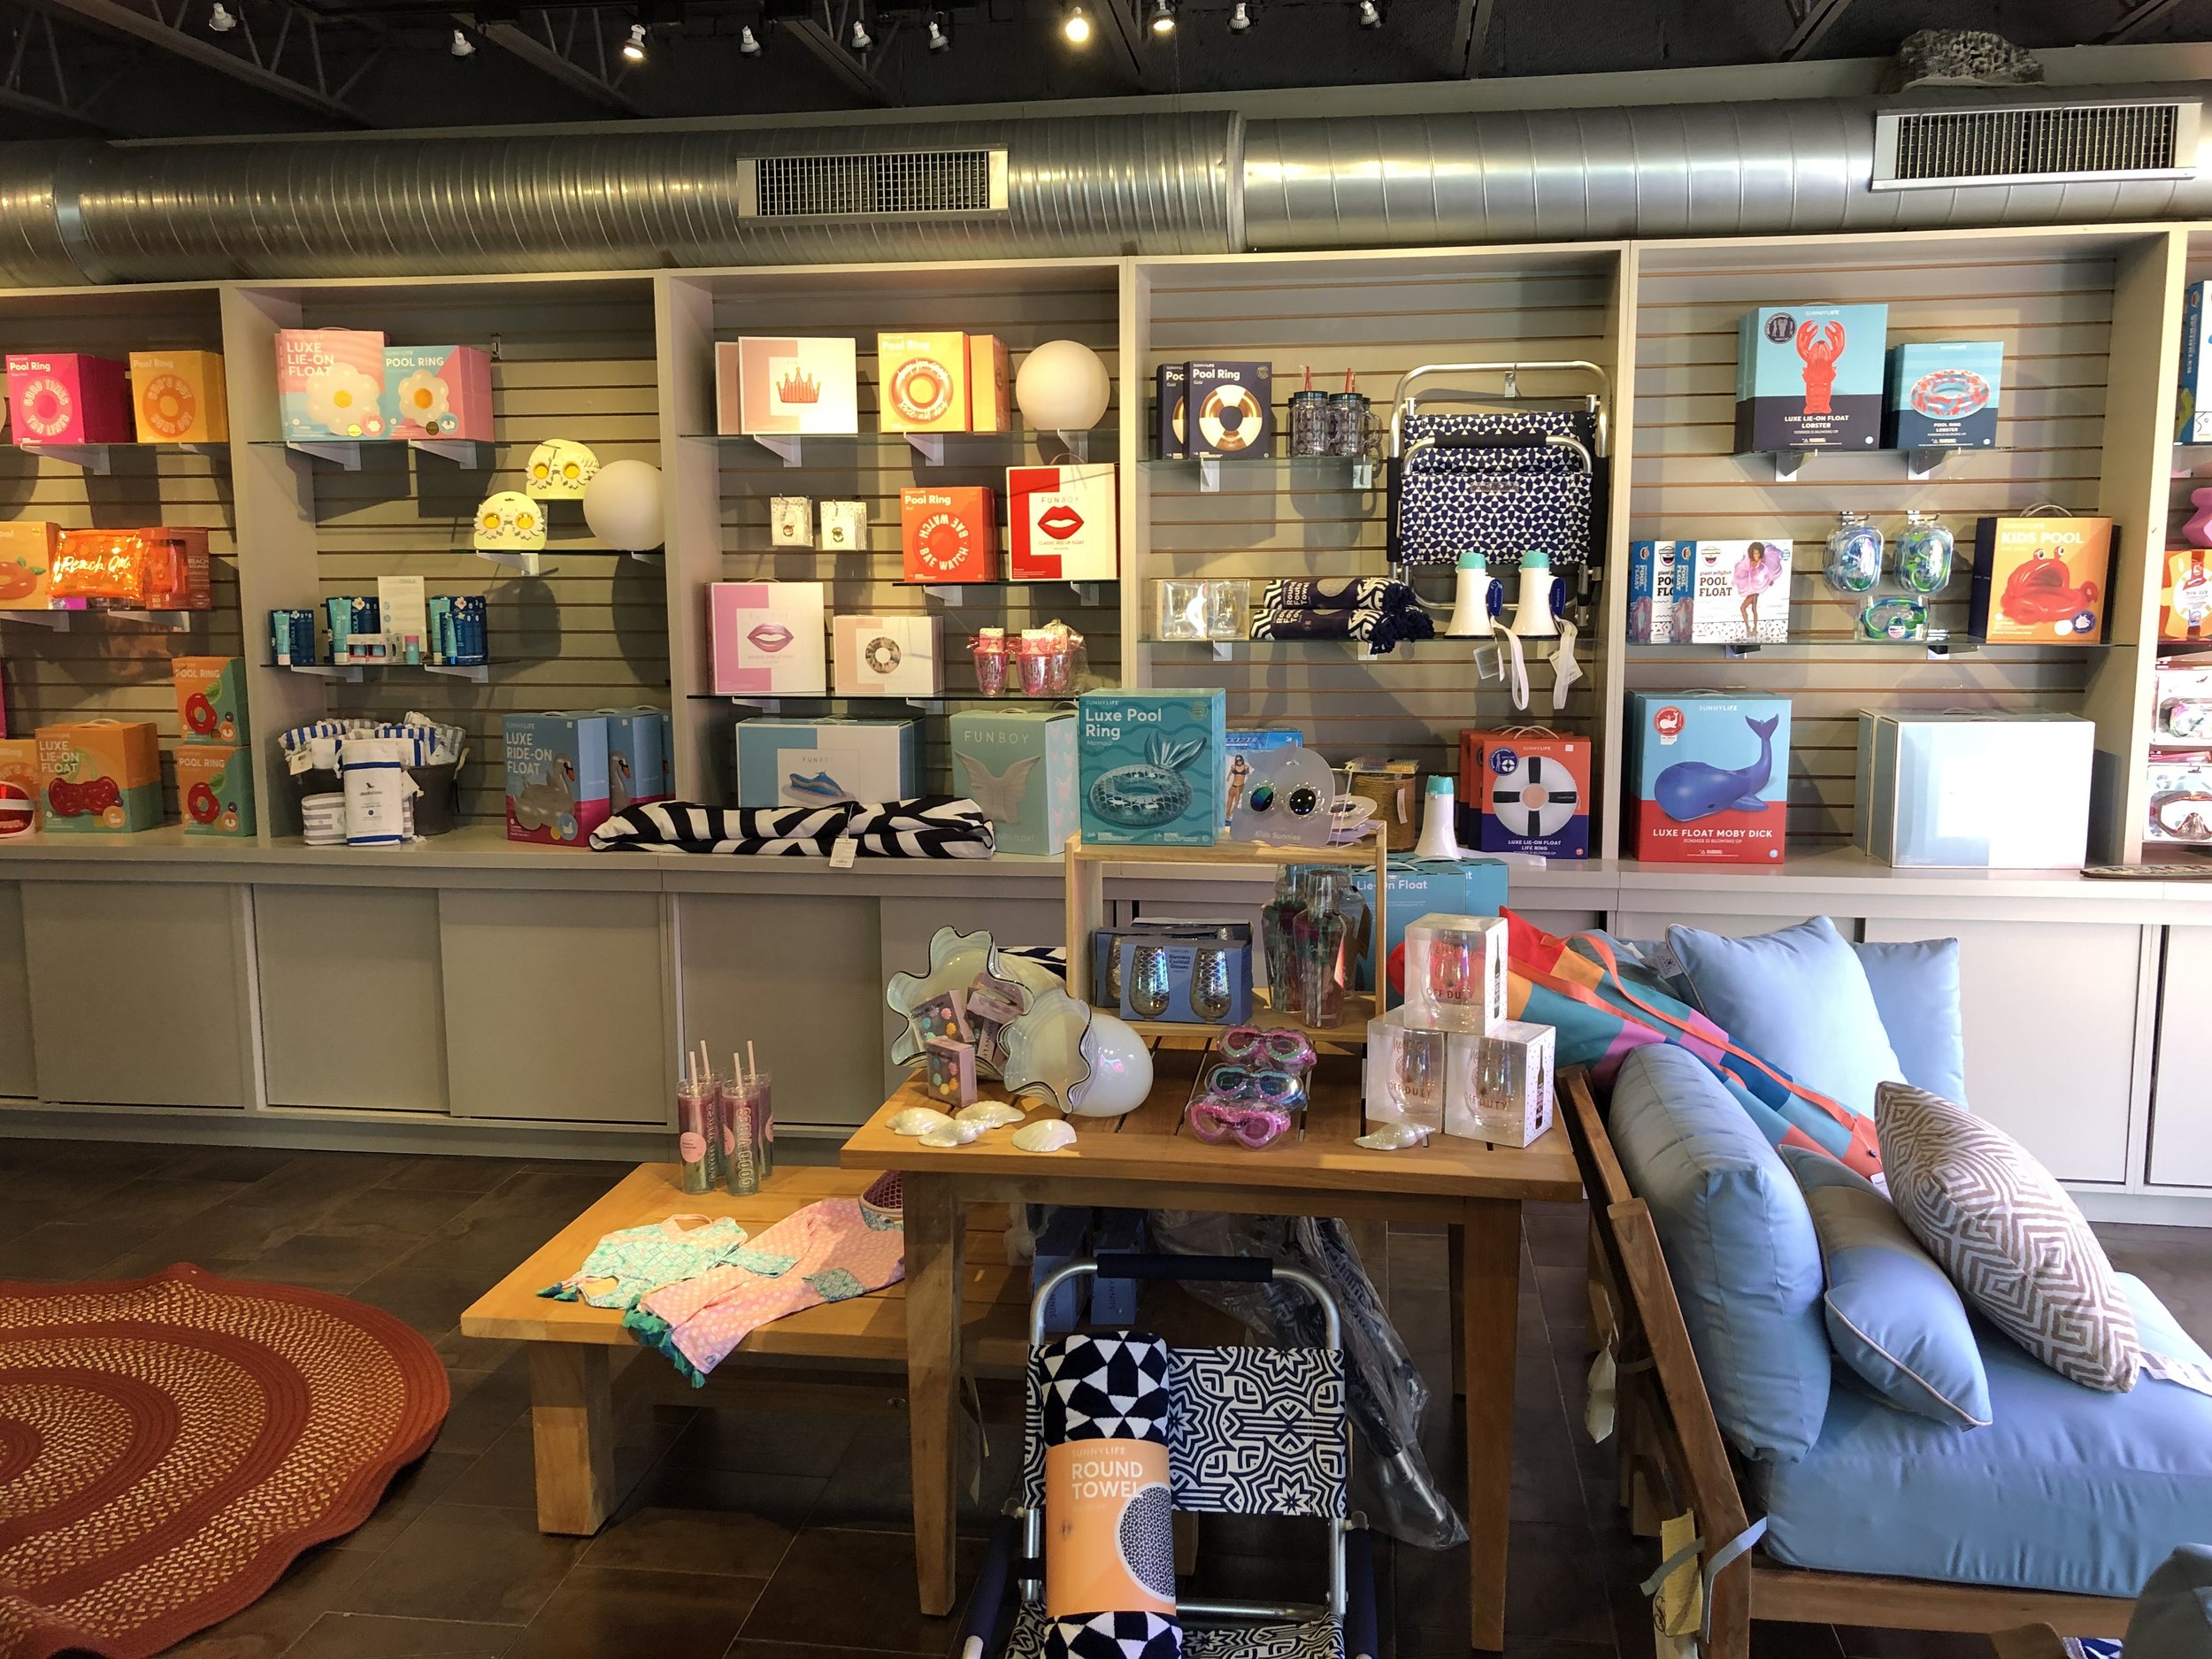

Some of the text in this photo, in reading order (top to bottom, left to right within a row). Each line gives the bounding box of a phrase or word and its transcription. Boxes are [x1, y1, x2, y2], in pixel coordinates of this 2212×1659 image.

[287, 342, 323, 353] LUXE
[133, 358, 174, 369] Pool Ring
[288, 354, 334, 365] LIE-ON
[386, 357, 444, 367] POOL RING
[10, 361, 50, 372] Pool Ring
[288, 365, 332, 377] FLOAT
[1166, 372, 1184, 380] Poo
[1193, 369, 1240, 380] Pool Ring
[904, 495, 951, 505] Pool Ring
[918, 514, 969, 539] BAE WATCH
[2001, 532, 2084, 544] KIDS POOL
[919, 546, 969, 571] BAE WATCH
[1699, 577, 1728, 587] POOL
[1699, 588, 1732, 597] FLOAT
[176, 669, 220, 679] POOL RING
[1085, 708, 1162, 722] Luxe Pool
[964, 730, 1030, 744] FUNBOY
[1085, 724, 1121, 741] Ring
[506, 733, 533, 746] LUXE
[39, 741, 69, 751] LUXE
[40, 752, 80, 762] LIE-ON
[506, 747, 552, 762] RIDE-ON
[42, 763, 78, 772] FLOAT
[179, 757, 225, 768] POOL RING
[507, 761, 541, 774] FLOAT
[1653, 828, 1678, 837] LUXE
[1748, 829, 1773, 838] DICK
[1356, 879, 1427, 890] Lie-n Float
[1447, 990, 1474, 1000] DUY
[1479, 1100, 1508, 1110] DUTY
[737, 1107, 753, 1188] GOOD VIBES
[1071, 1446, 1126, 1458] SUNNYLIFE
[1071, 1460, 1143, 1480] ROUND
[1071, 1479, 1141, 1501] TOWEL
